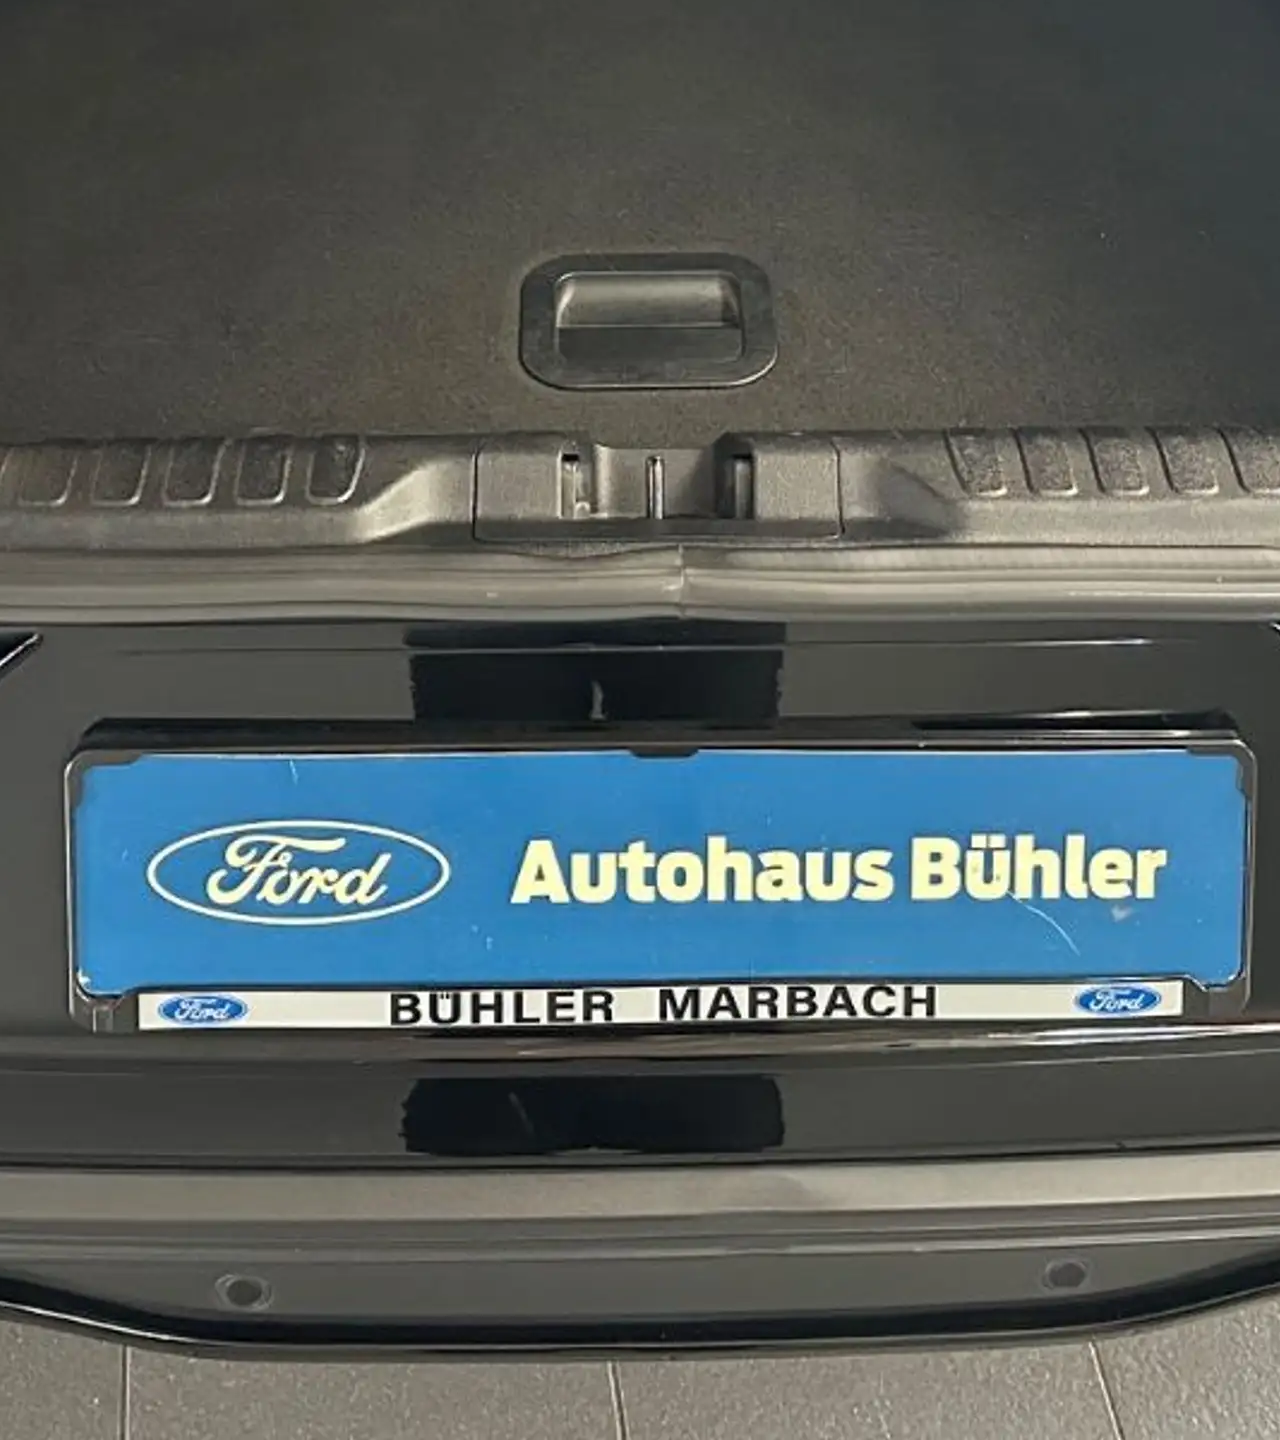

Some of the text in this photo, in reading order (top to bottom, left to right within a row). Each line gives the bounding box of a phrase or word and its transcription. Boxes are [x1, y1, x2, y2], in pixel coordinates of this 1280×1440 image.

[205, 833, 392, 905] Ford
[510, 832, 1168, 904] Autohaus Bühler
[389, 986, 937, 1026] BÜHLER MARBACH
